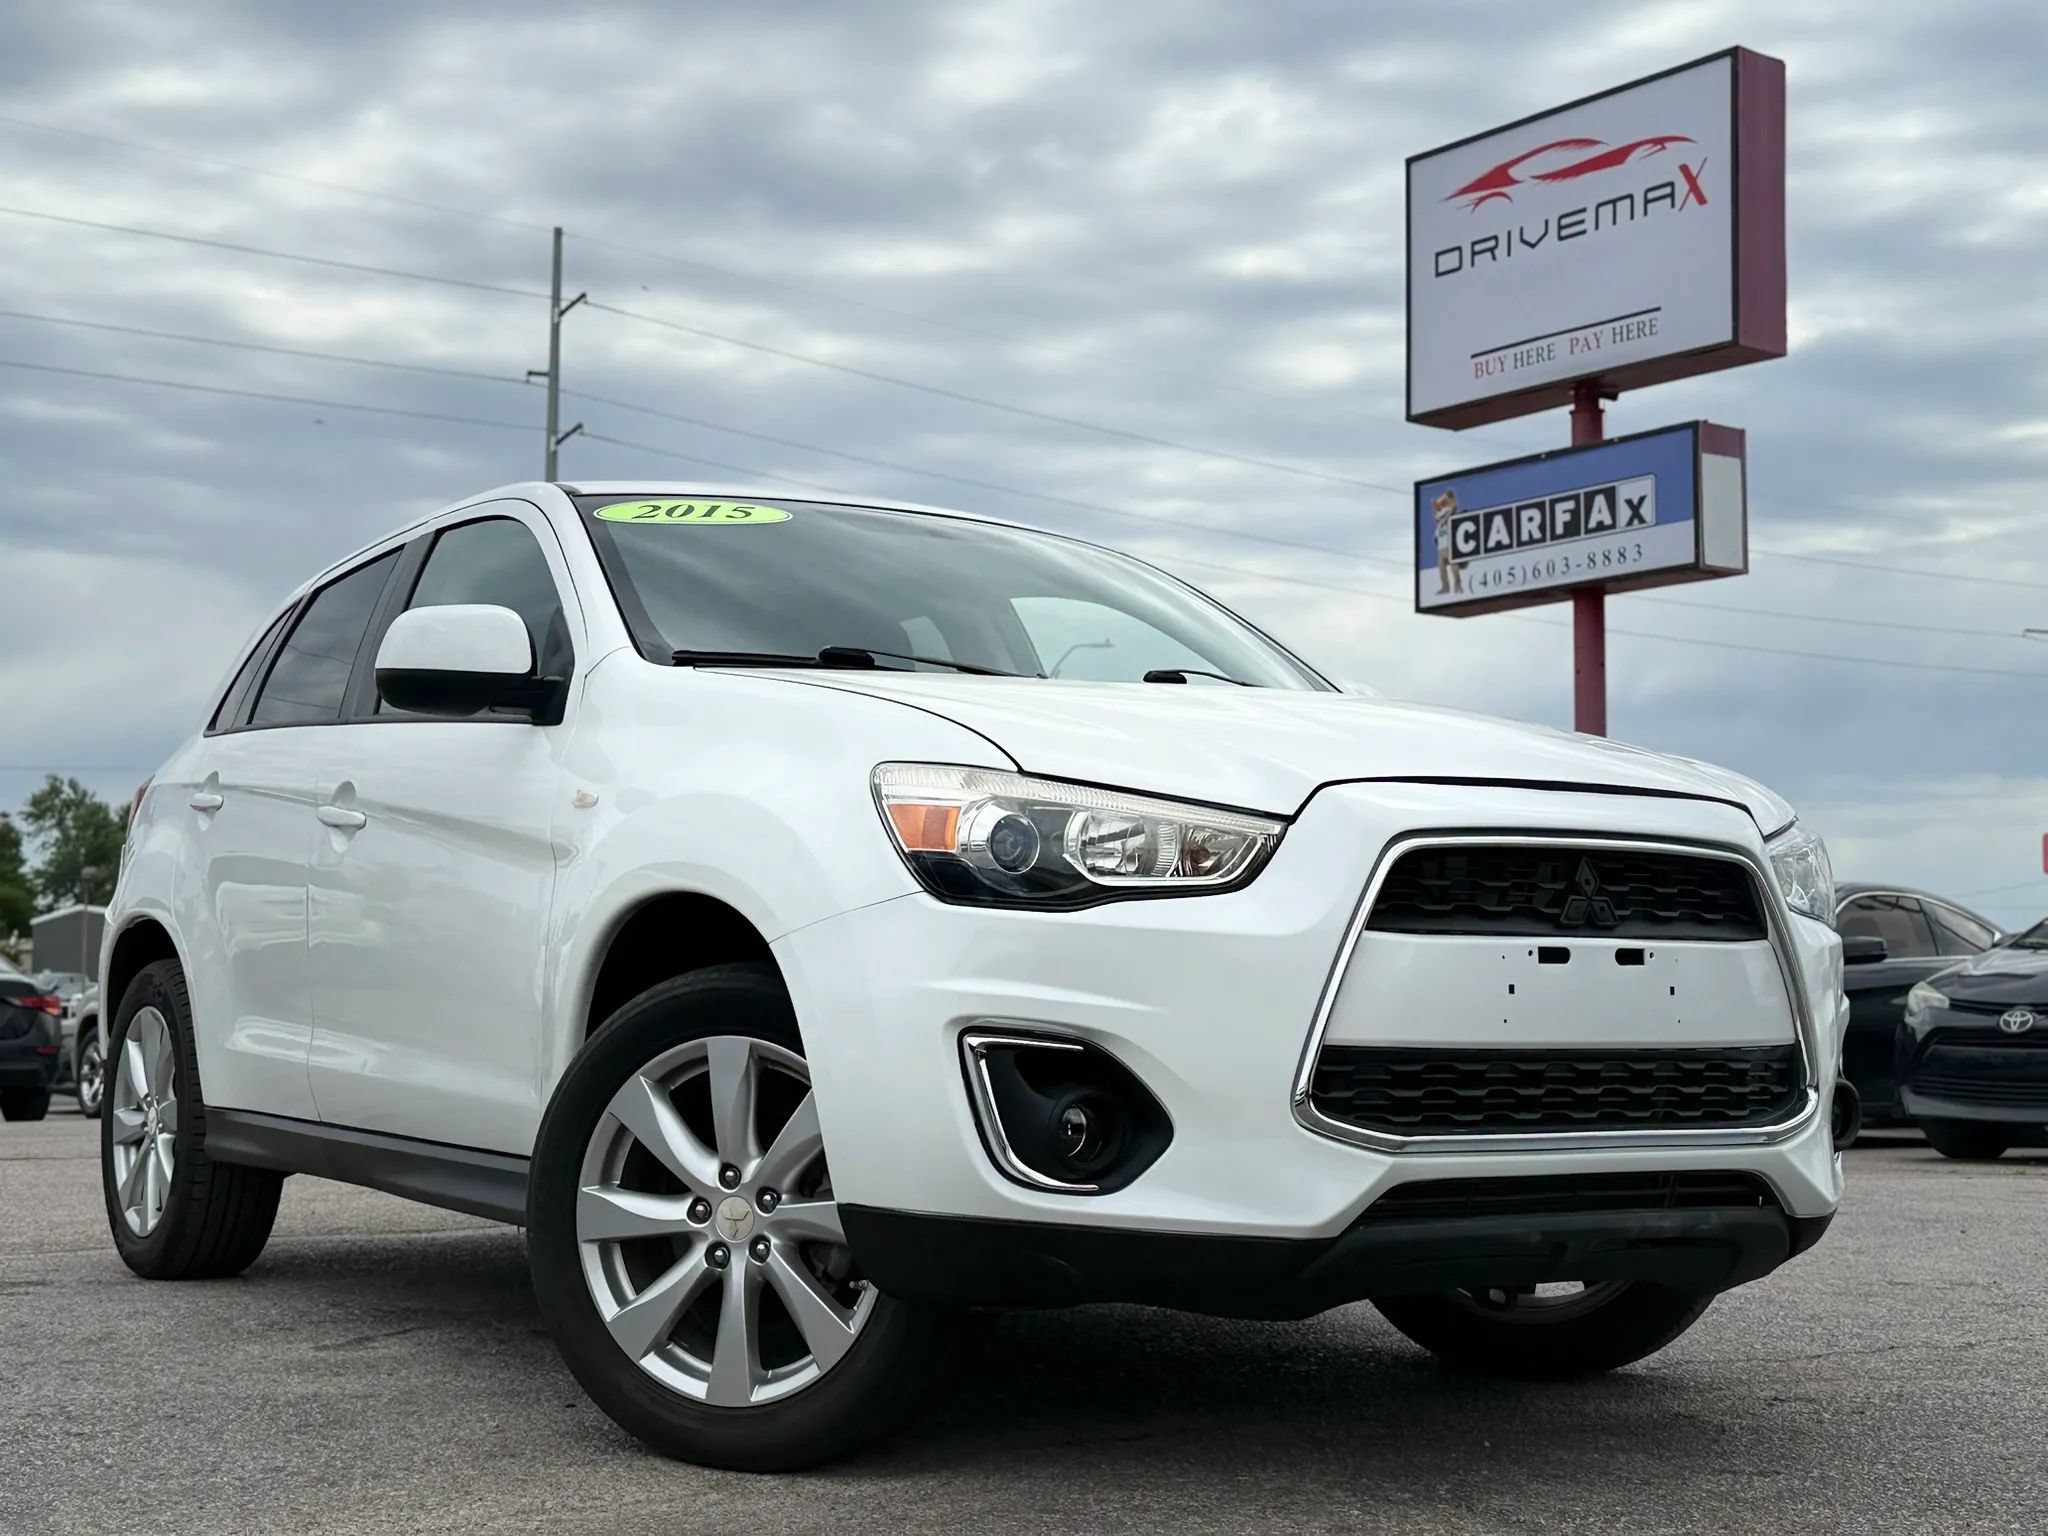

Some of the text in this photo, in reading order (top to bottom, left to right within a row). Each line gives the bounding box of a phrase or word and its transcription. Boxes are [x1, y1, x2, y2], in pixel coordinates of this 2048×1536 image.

[1435, 157, 1708, 278] DRIVEMAX
[1474, 318, 1659, 379] BUY HERE PAY HERE
[632, 504, 756, 519] 2015
[1455, 493, 1648, 554] CARFAX
[1468, 543, 1643, 594] (405)603-8883
